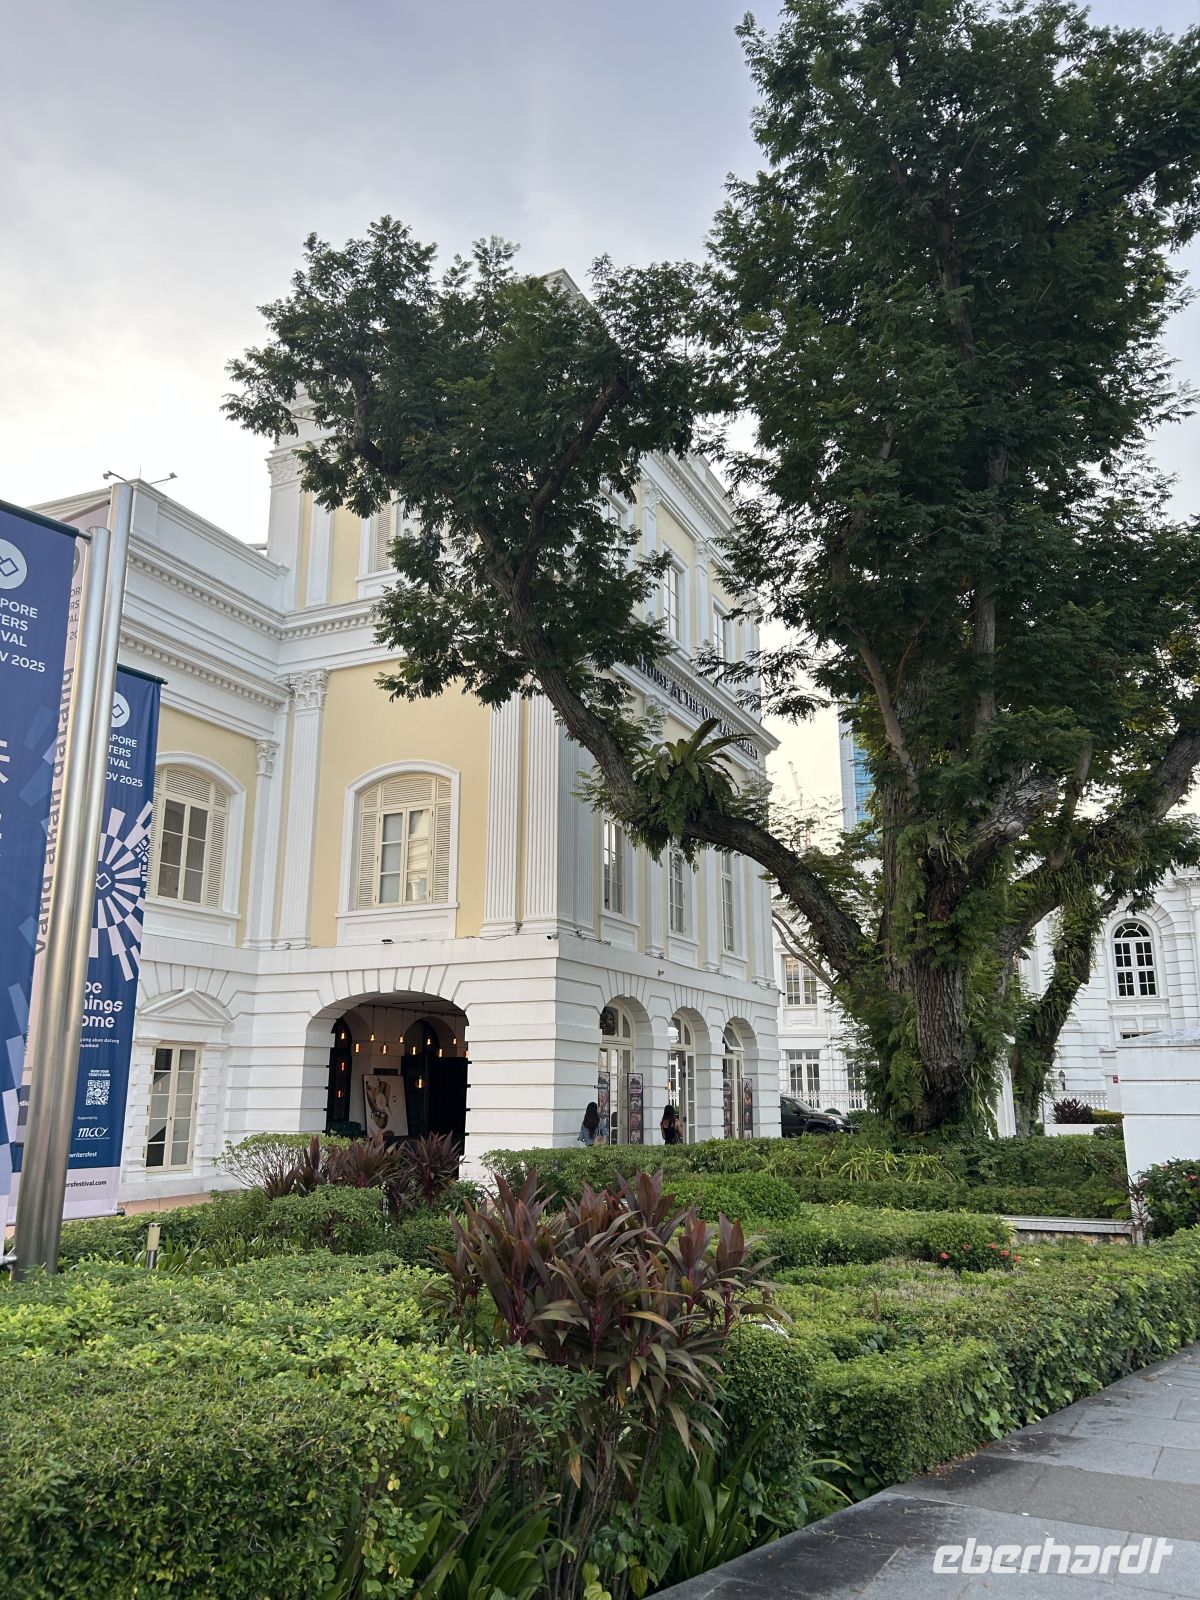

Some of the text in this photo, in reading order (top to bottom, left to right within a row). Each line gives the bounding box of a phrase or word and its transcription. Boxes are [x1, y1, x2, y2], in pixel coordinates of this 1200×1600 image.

[0, 613, 28, 631] ERS
[11, 655, 46, 673] 2025
[109, 733, 138, 748] PORE
[119, 775, 143, 787] 2025
